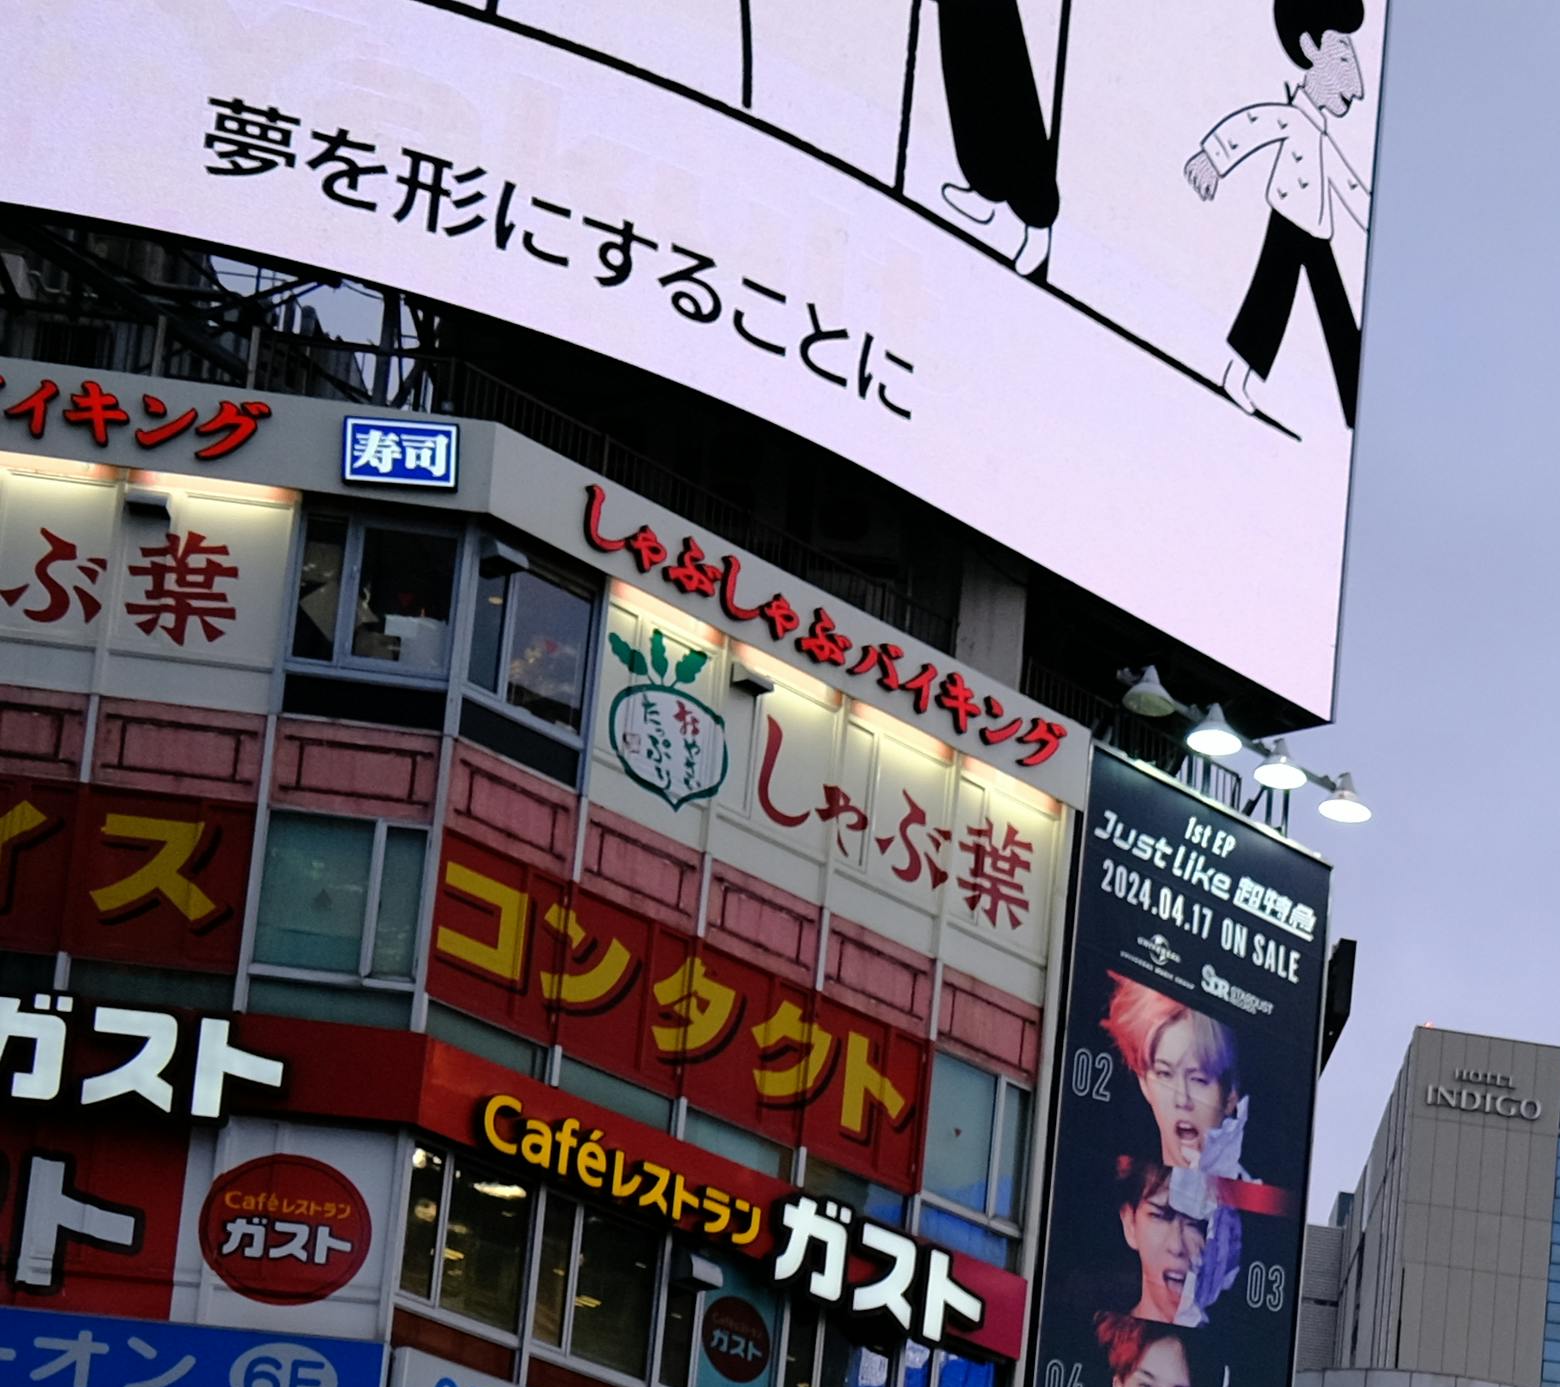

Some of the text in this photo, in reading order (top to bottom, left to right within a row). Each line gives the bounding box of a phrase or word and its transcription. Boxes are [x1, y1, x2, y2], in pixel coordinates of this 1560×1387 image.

[204, 96, 914, 421] 夢を形にすることに
[0, 375, 272, 460] イキング
[352, 427, 452, 480] 寿司
[583, 484, 1067, 768] しゃぶしゃぶバイキング
[756, 713, 1033, 930] しゃぶ葉
[1212, 828, 1237, 857] EP
[1101, 859, 1301, 984] 2024.04.17 ON SALE
[436, 860, 908, 1137] コンタクト
[0, 993, 284, 1118] ガスト
[1072, 1048, 1113, 1102] 02
[1455, 1068, 1516, 1090] HOTEL
[1426, 1084, 1543, 1122] INDIGO
[220, 1217, 352, 1267] ガスト
[485, 1093, 983, 1345] Caféレストラン ガスト
[1246, 1261, 1285, 1312] 03
